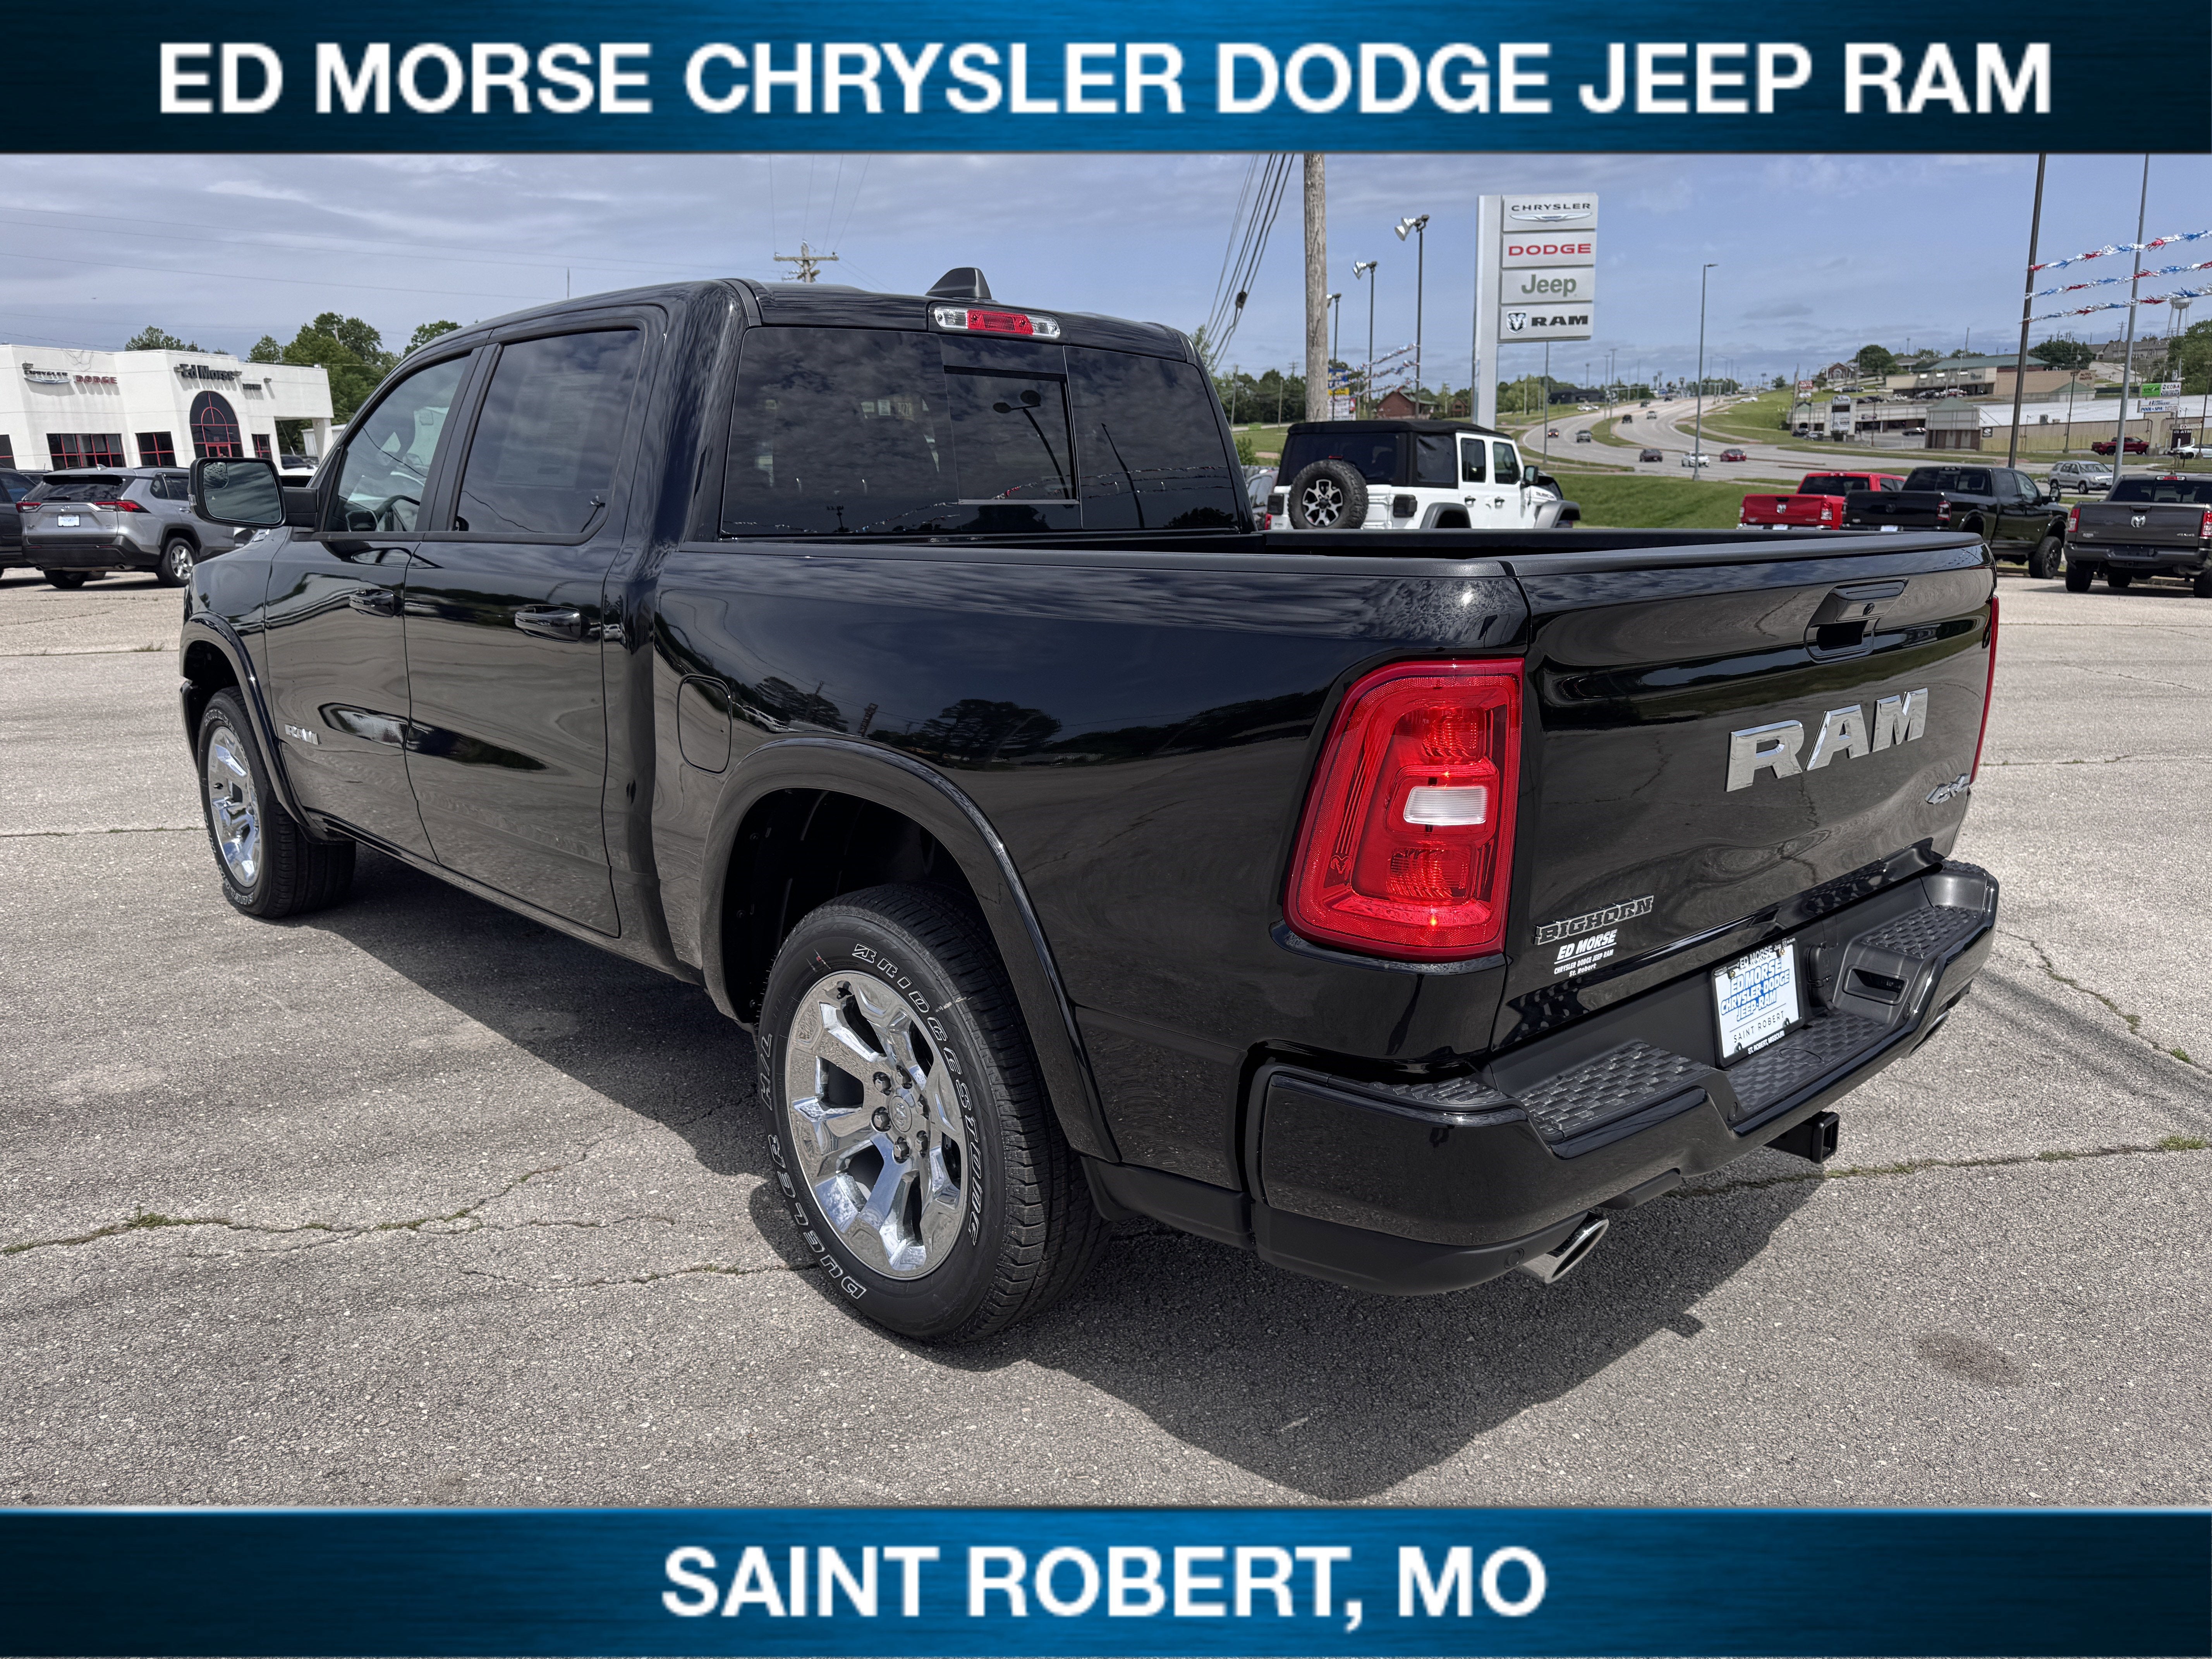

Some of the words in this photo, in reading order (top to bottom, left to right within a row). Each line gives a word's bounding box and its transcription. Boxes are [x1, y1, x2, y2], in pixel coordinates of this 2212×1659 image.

[1511, 203, 1591, 211] CHRYSLER
[1508, 243, 1591, 256] DODGE
[1521, 274, 1577, 297] Jeep
[1531, 315, 1588, 327] RAM
[76, 375, 117, 384] DODGE
[285, 723, 320, 745] RAM
[1724, 687, 1928, 792] RAM
[1532, 895, 1654, 945] BIGHORN
[1557, 943, 1575, 960] ED
[1575, 929, 1618, 954] MORSE
[1739, 956, 1749, 969] ED
[1749, 945, 1773, 967] MORSE
[1554, 961, 1577, 975] CHRYSLER
[1577, 956, 1592, 967] DODGE
[1592, 953, 1603, 962] JEEP
[1603, 949, 1614, 958] RAM
[1577, 963, 1597, 974] Robert
[1731, 974, 1744, 996] ED
[1744, 958, 1782, 989] MORSE
[1734, 1025, 1754, 1043] SAINT
[1758, 1010, 1784, 1031] ROBERT
[759, 1033, 773, 1111] H/L
[852, 943, 983, 1246] BRIDGESTONE
[768, 1134, 866, 1300] DUELER
